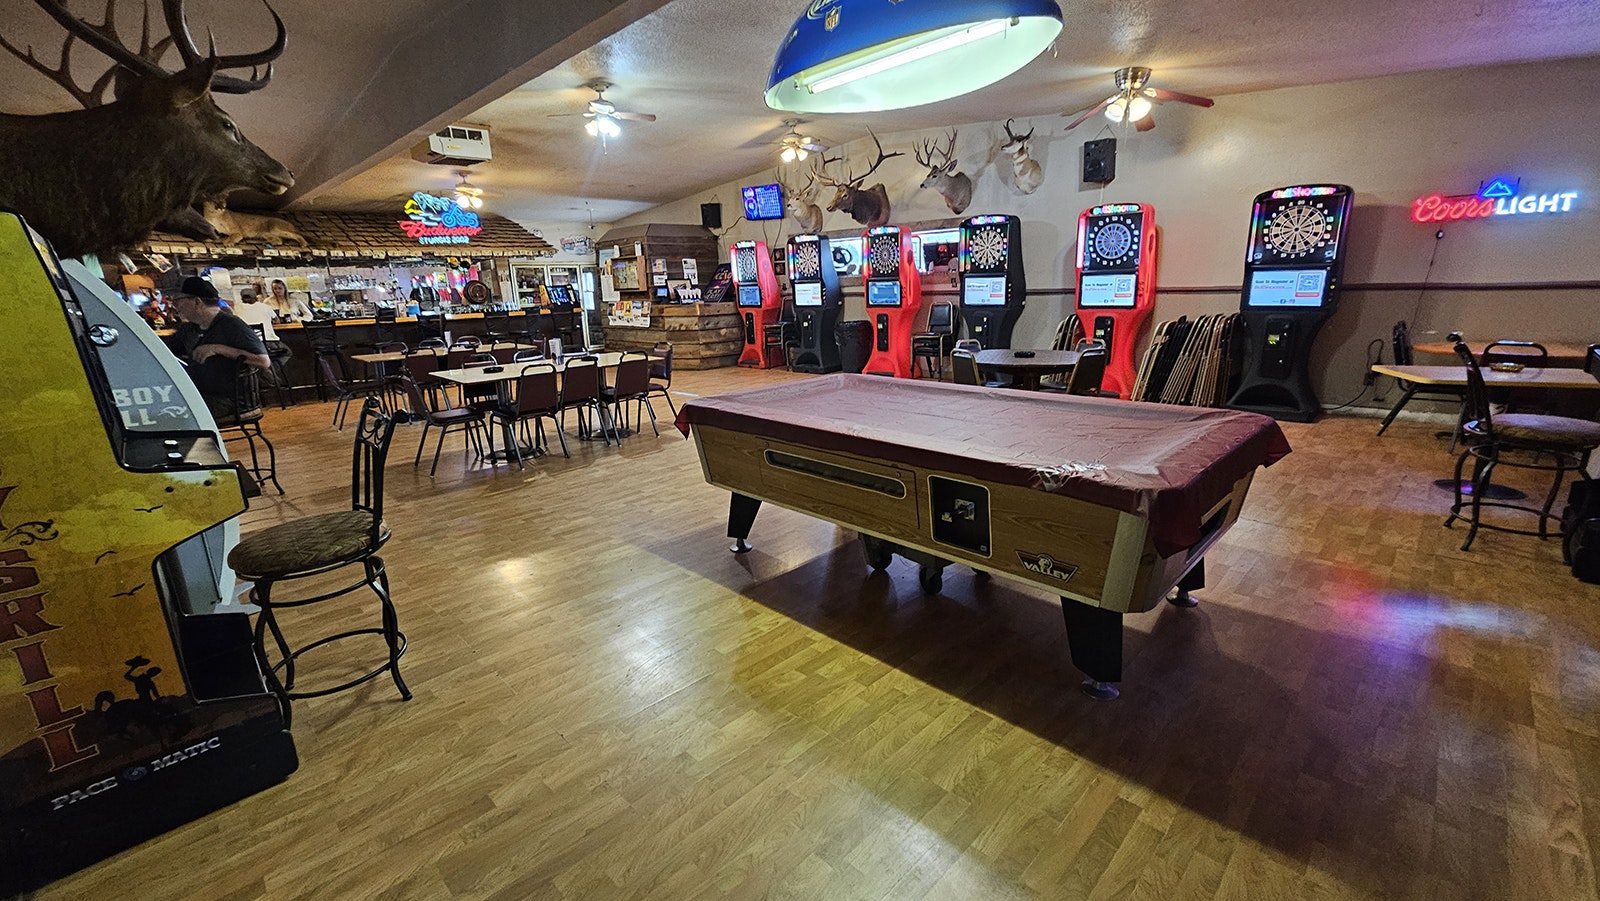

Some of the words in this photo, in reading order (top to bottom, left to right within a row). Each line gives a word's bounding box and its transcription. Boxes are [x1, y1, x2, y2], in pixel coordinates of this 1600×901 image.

[1413, 194, 1496, 223] Coors
[1496, 192, 1579, 216] LIGHT
[399, 220, 483, 238] Budweiser
[111, 385, 173, 408] BOY
[119, 408, 157, 427] LL
[1023, 560, 1070, 580] VALLEY
[50, 775, 119, 811] PACE
[150, 736, 222, 772] MATIC
